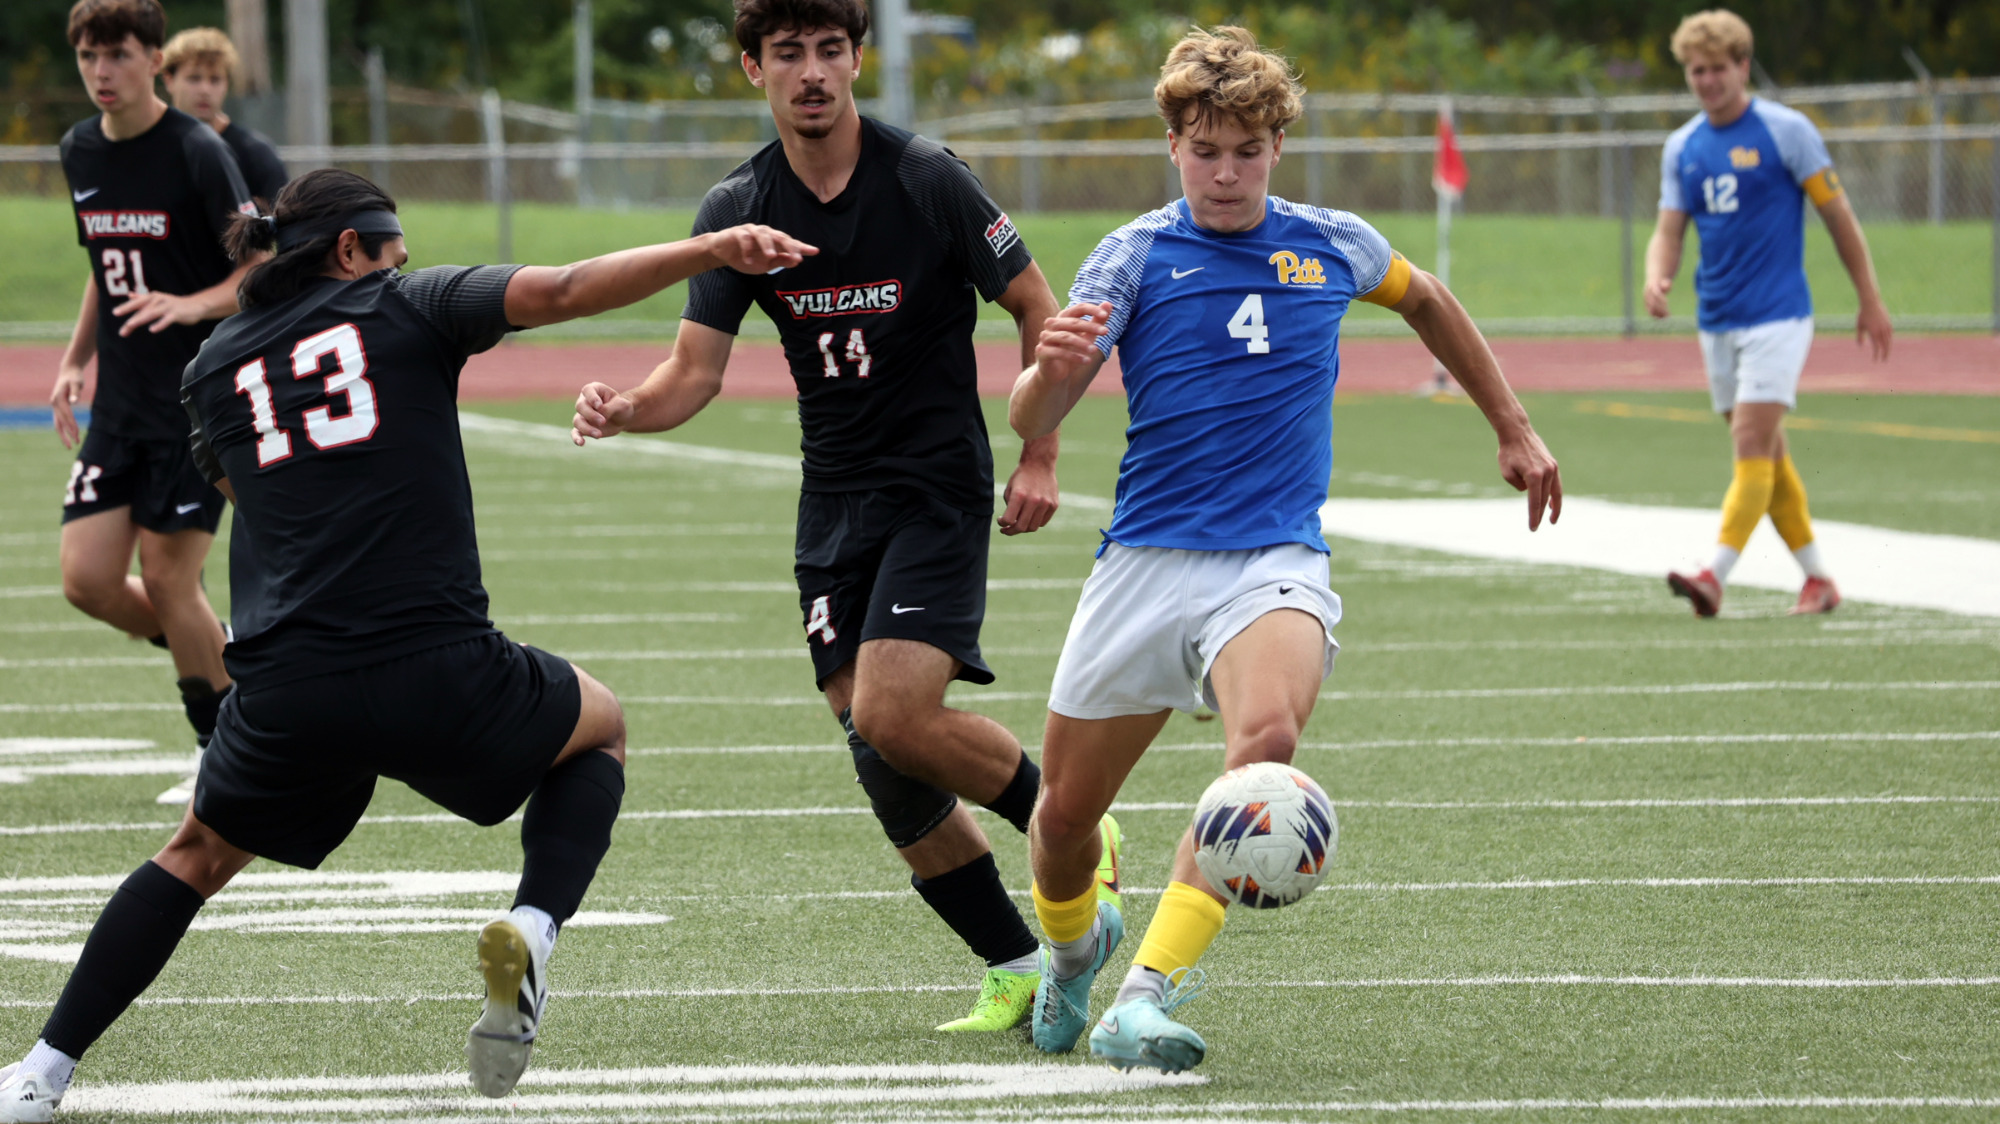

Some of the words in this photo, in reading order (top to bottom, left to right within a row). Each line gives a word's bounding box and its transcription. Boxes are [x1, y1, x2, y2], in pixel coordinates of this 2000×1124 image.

[1703, 172, 1739, 214] 12
[82, 211, 169, 239] VULCANS
[102, 248, 150, 297] 21
[1268, 250, 1327, 284] Pitt
[778, 281, 901, 317] VULCANS
[1226, 293, 1270, 354] 4
[818, 328, 872, 378] 14
[234, 322, 380, 468] 13
